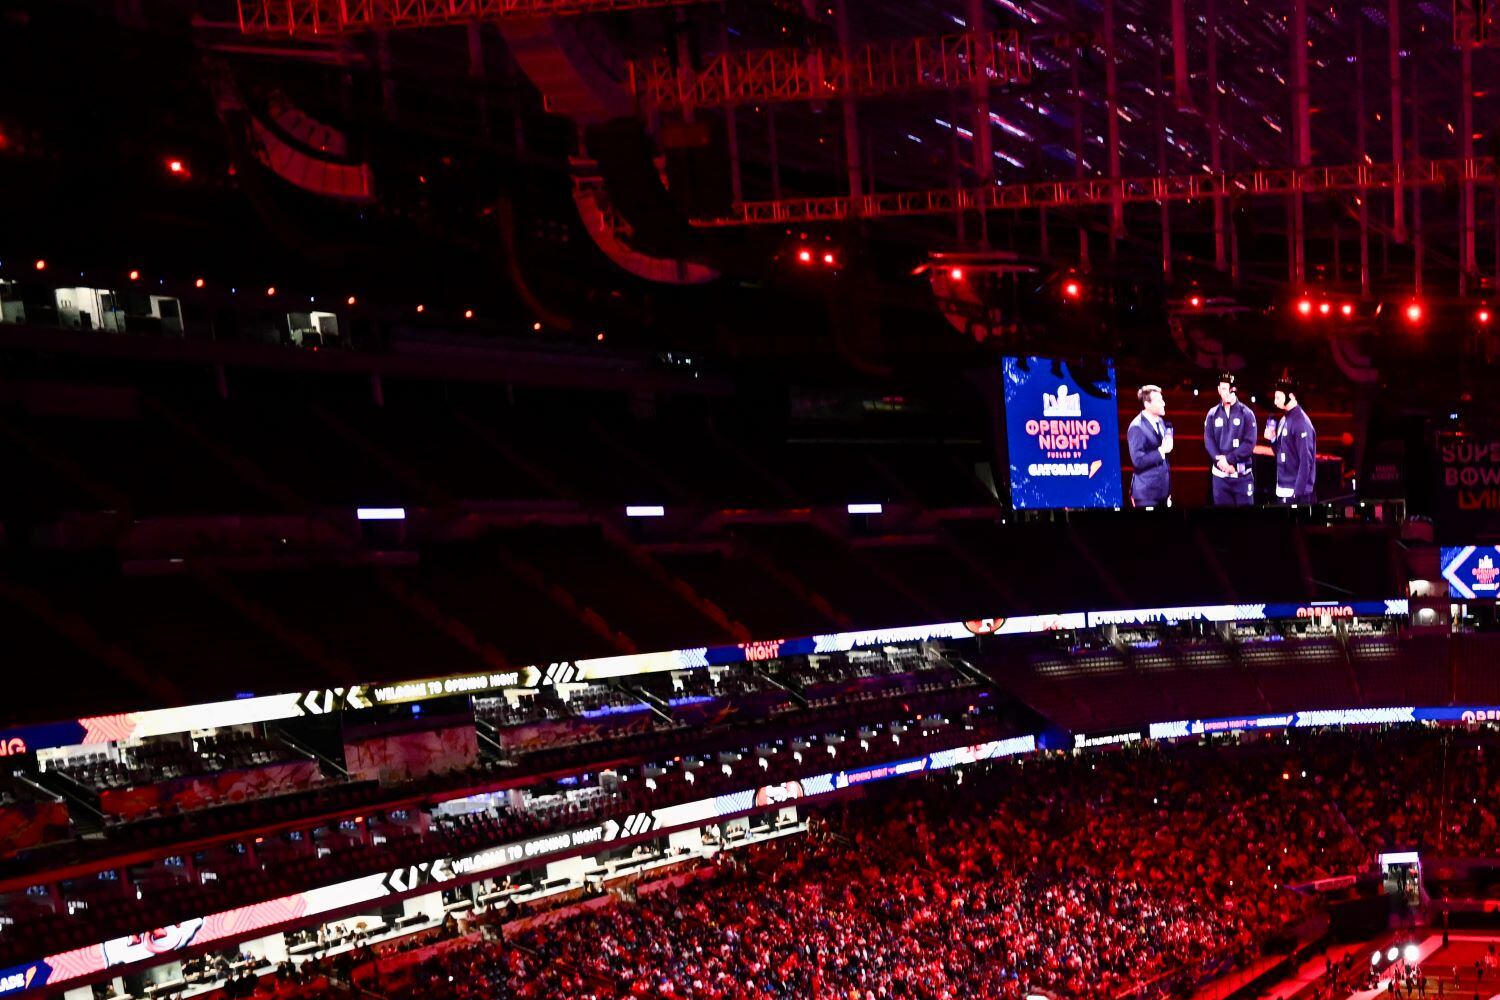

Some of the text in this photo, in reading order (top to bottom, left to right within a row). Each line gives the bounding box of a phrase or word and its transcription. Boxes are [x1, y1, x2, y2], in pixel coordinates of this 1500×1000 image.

[1026, 420, 1100, 436] OPENING
[1039, 434, 1089, 450] NIGHT
[1028, 463, 1089, 476] GATORADE
[744, 643, 779, 661] NIGHT
[374, 672, 519, 702] WELCOME TO OPENING NIGHT
[451, 827, 603, 875] WELCOME TO OPENING NIGHT
